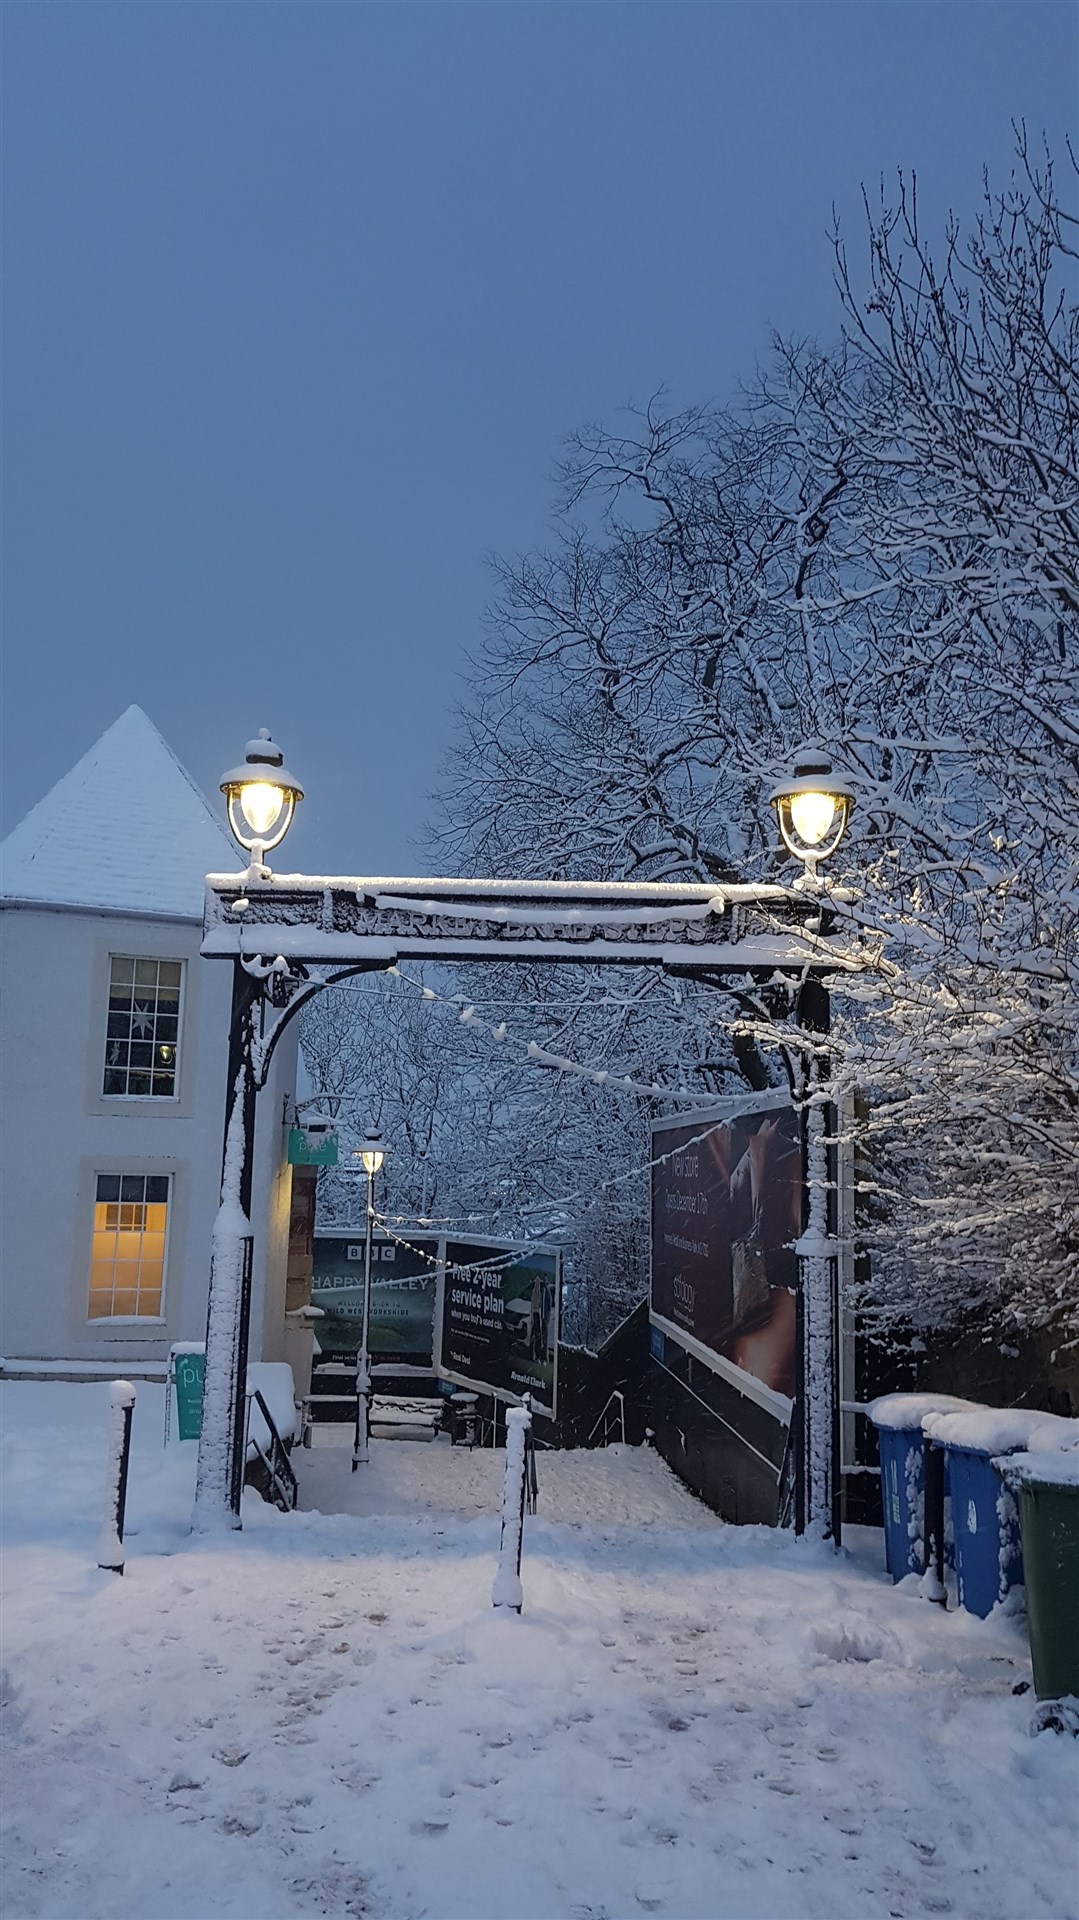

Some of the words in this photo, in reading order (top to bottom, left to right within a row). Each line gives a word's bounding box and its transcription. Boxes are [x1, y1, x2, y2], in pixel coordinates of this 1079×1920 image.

[503, 920, 593, 940] BRAE
[603, 917, 707, 941] STEPS
[684, 1152, 699, 1178] store
[311, 1276, 363, 1289] HAPPY
[370, 1277, 429, 1290] VALLEY
[452, 1263, 471, 1283] Free
[472, 1267, 502, 1289] 2-year
[347, 1307, 363, 1315] WES
[451, 1288, 482, 1309] service
[484, 1292, 504, 1314] plan
[450, 1309, 462, 1319] when
[462, 1312, 470, 1322] you
[471, 1313, 479, 1325] buy
[483, 1319, 494, 1327] used
[510, 1371, 530, 1385] Arnold
[530, 1377, 546, 1389] Clark
